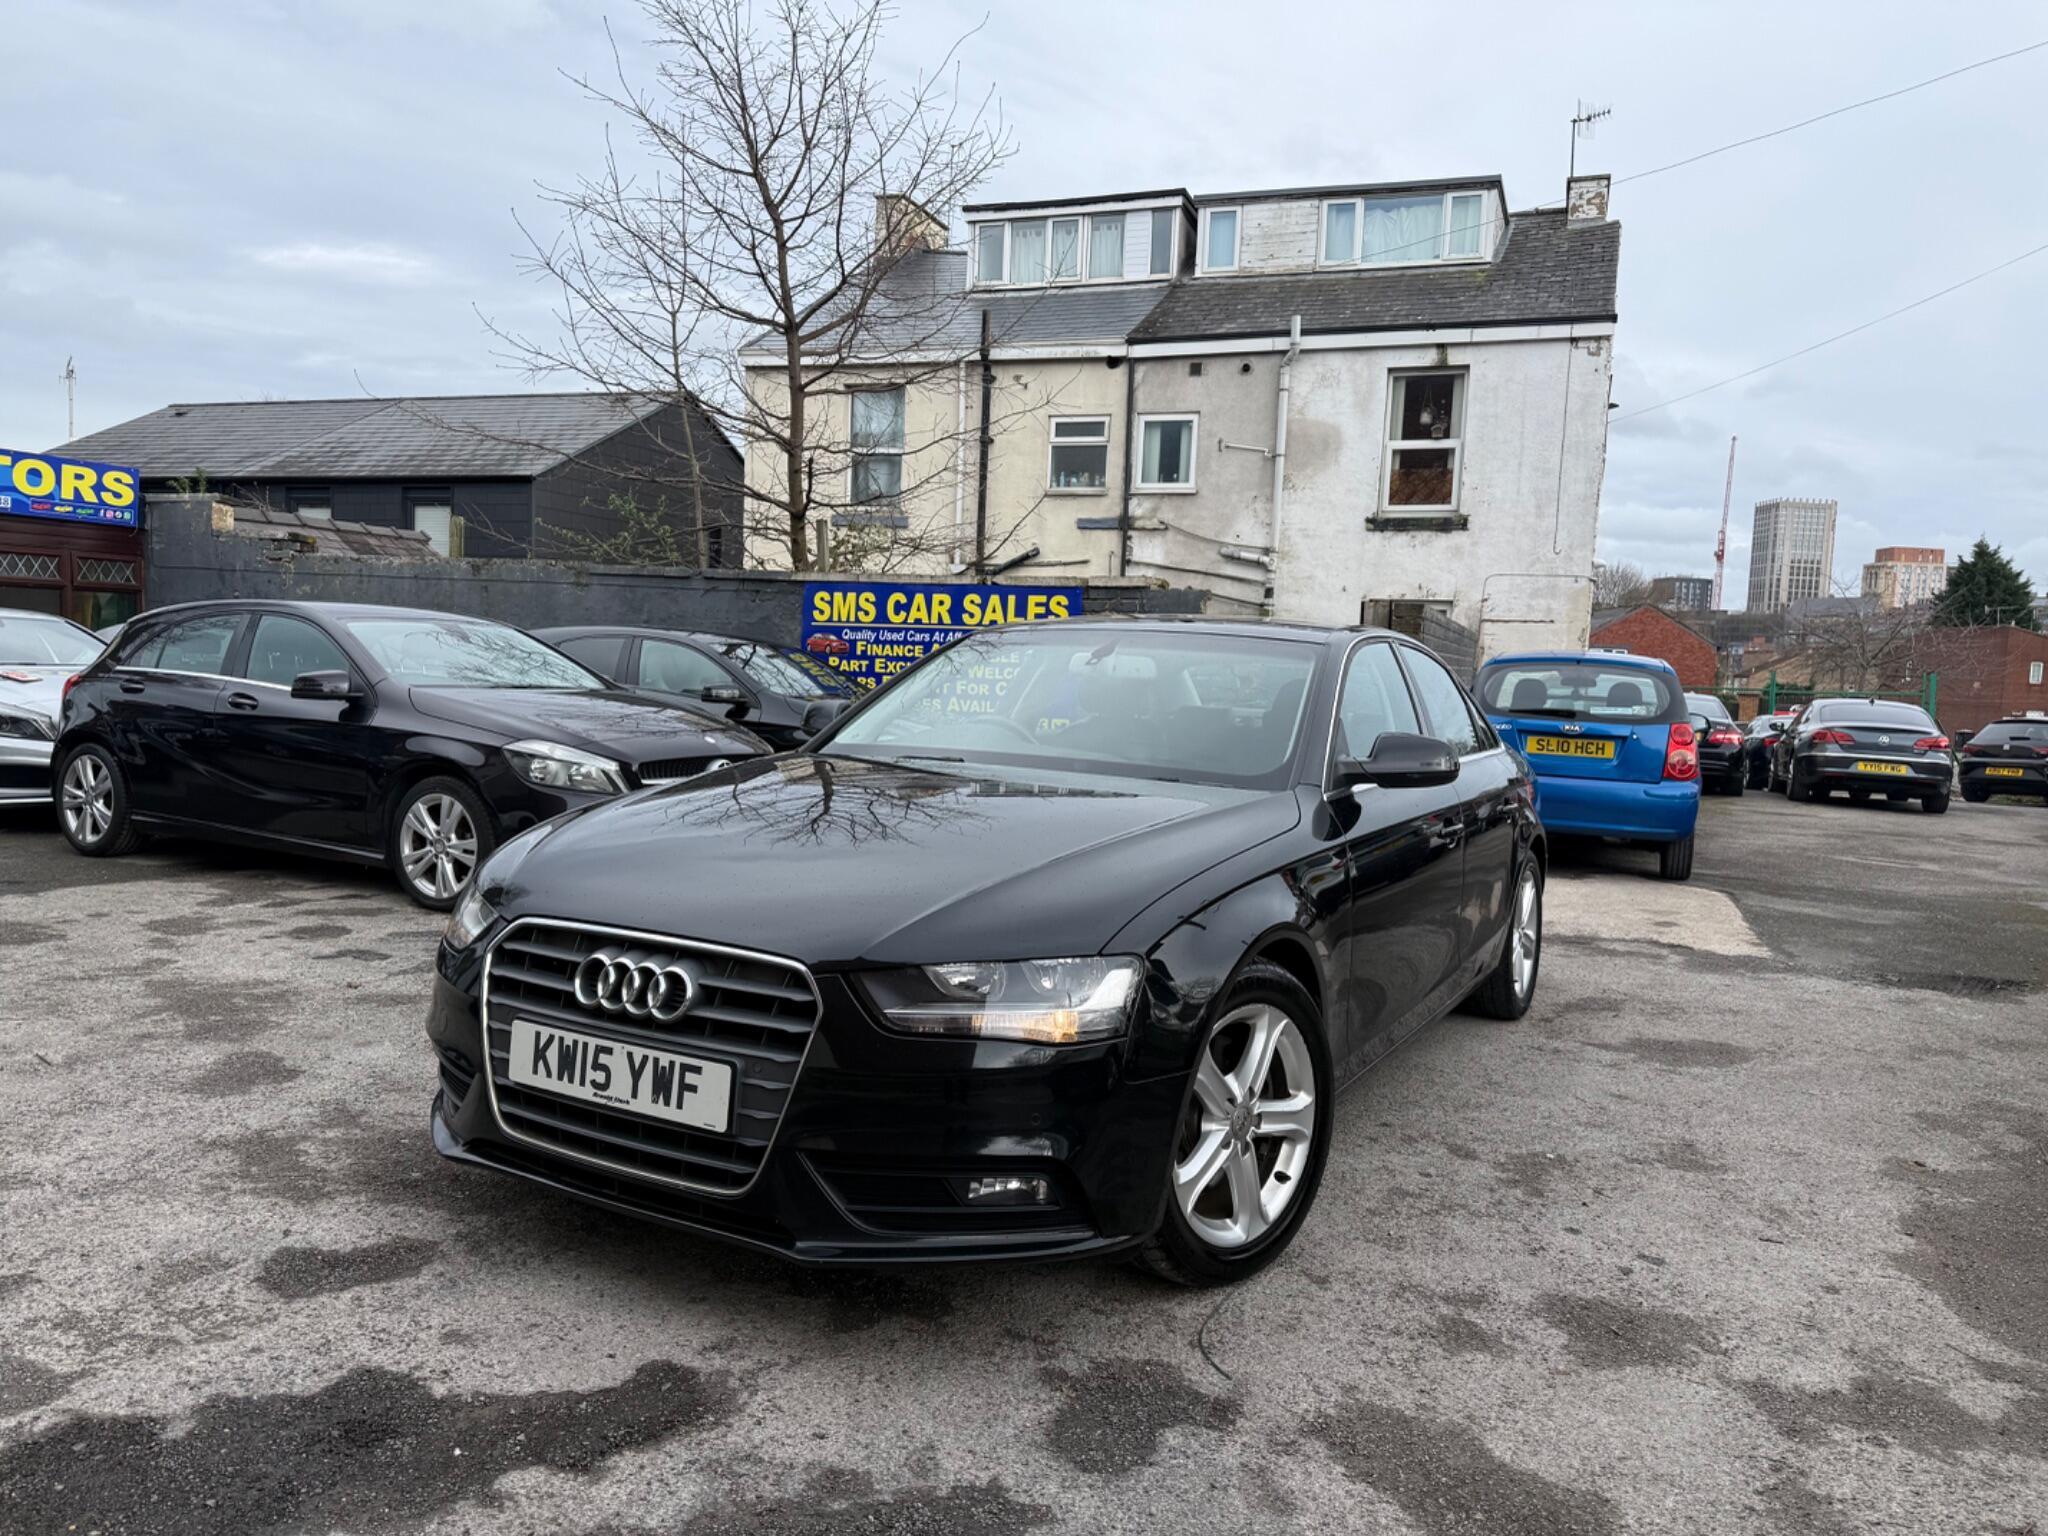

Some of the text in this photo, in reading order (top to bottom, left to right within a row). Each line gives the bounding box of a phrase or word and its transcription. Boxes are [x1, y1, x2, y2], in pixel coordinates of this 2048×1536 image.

[0, 455, 134, 507] ORS
[813, 591, 1069, 625] SMS CAR SALES
[842, 628, 877, 642] Quality
[879, 630, 905, 641] Used
[907, 630, 930, 642] Cars
[932, 632, 944, 642] At
[829, 656, 869, 672] PART
[947, 697, 995, 713] AVAIL
[1536, 738, 1570, 754] SL10
[532, 1030, 703, 1110] KW15 YWF
